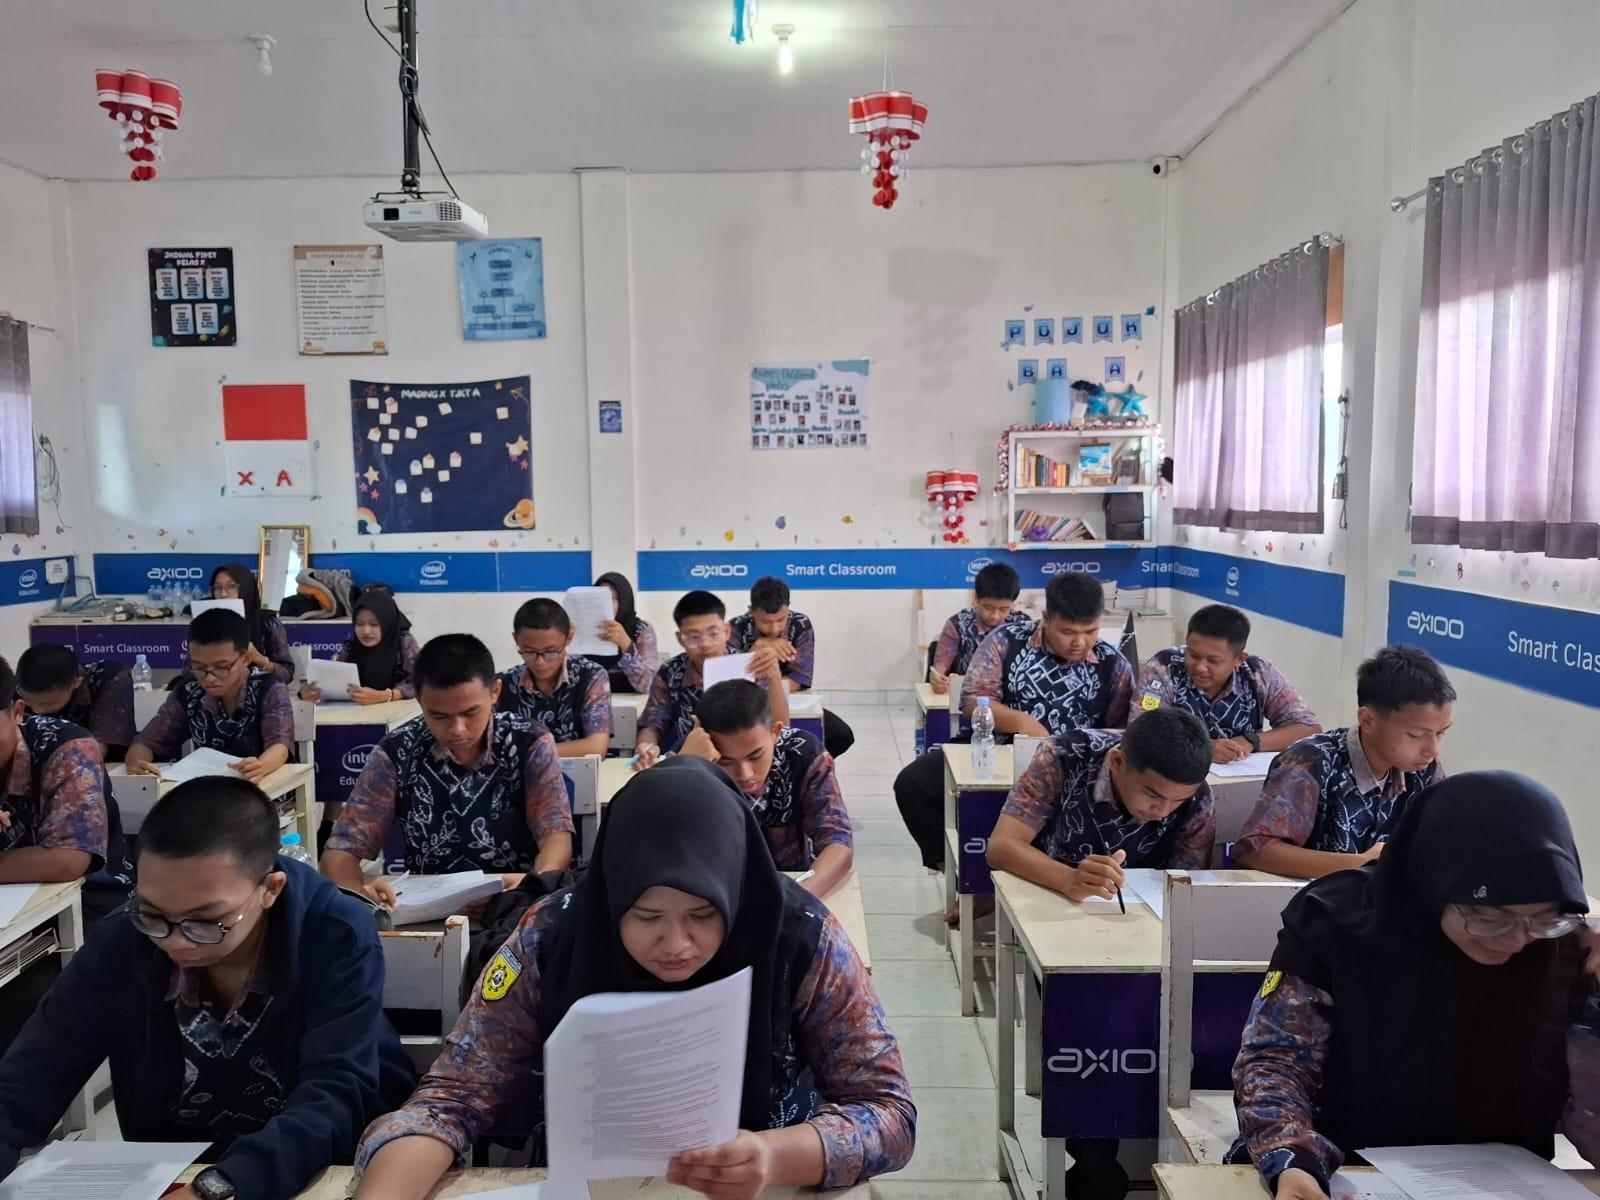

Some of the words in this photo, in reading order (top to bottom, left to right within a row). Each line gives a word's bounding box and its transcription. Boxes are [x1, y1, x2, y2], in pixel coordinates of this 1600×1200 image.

[164, 251, 194, 259] JADWAL
[195, 251, 217, 259] PIKET
[401, 389, 438, 399] MADING
[439, 390, 447, 399] X
[472, 387, 481, 398] A
[237, 470, 253, 486] X
[276, 469, 292, 487] A
[786, 563, 825, 576] Smart
[828, 563, 896, 576] Classroom
[83, 643, 114, 653] Smart
[117, 643, 170, 653] Classroom
[1507, 630, 1558, 663] Smart
[1046, 1047, 1194, 1080] axio
